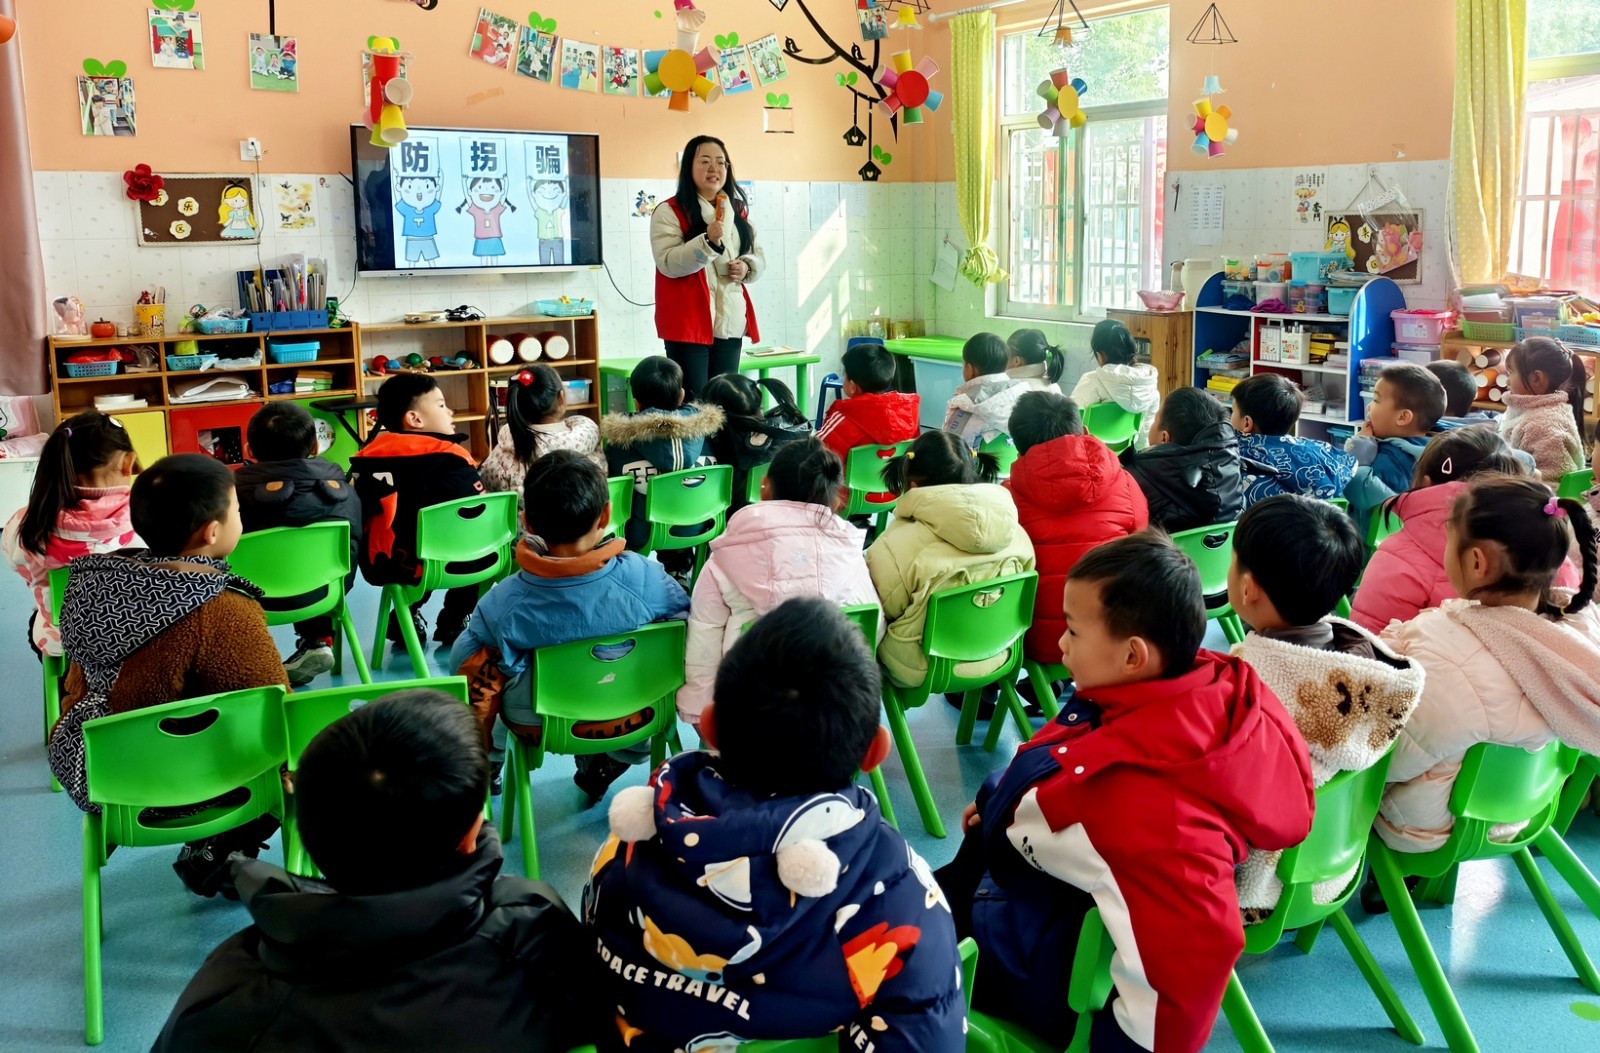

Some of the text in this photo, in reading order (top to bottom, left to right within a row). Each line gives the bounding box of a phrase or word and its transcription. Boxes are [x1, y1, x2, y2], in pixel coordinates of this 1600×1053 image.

[401, 141, 561, 174] 防 拐 骗
[653, 970, 751, 1021] TRAVEL
